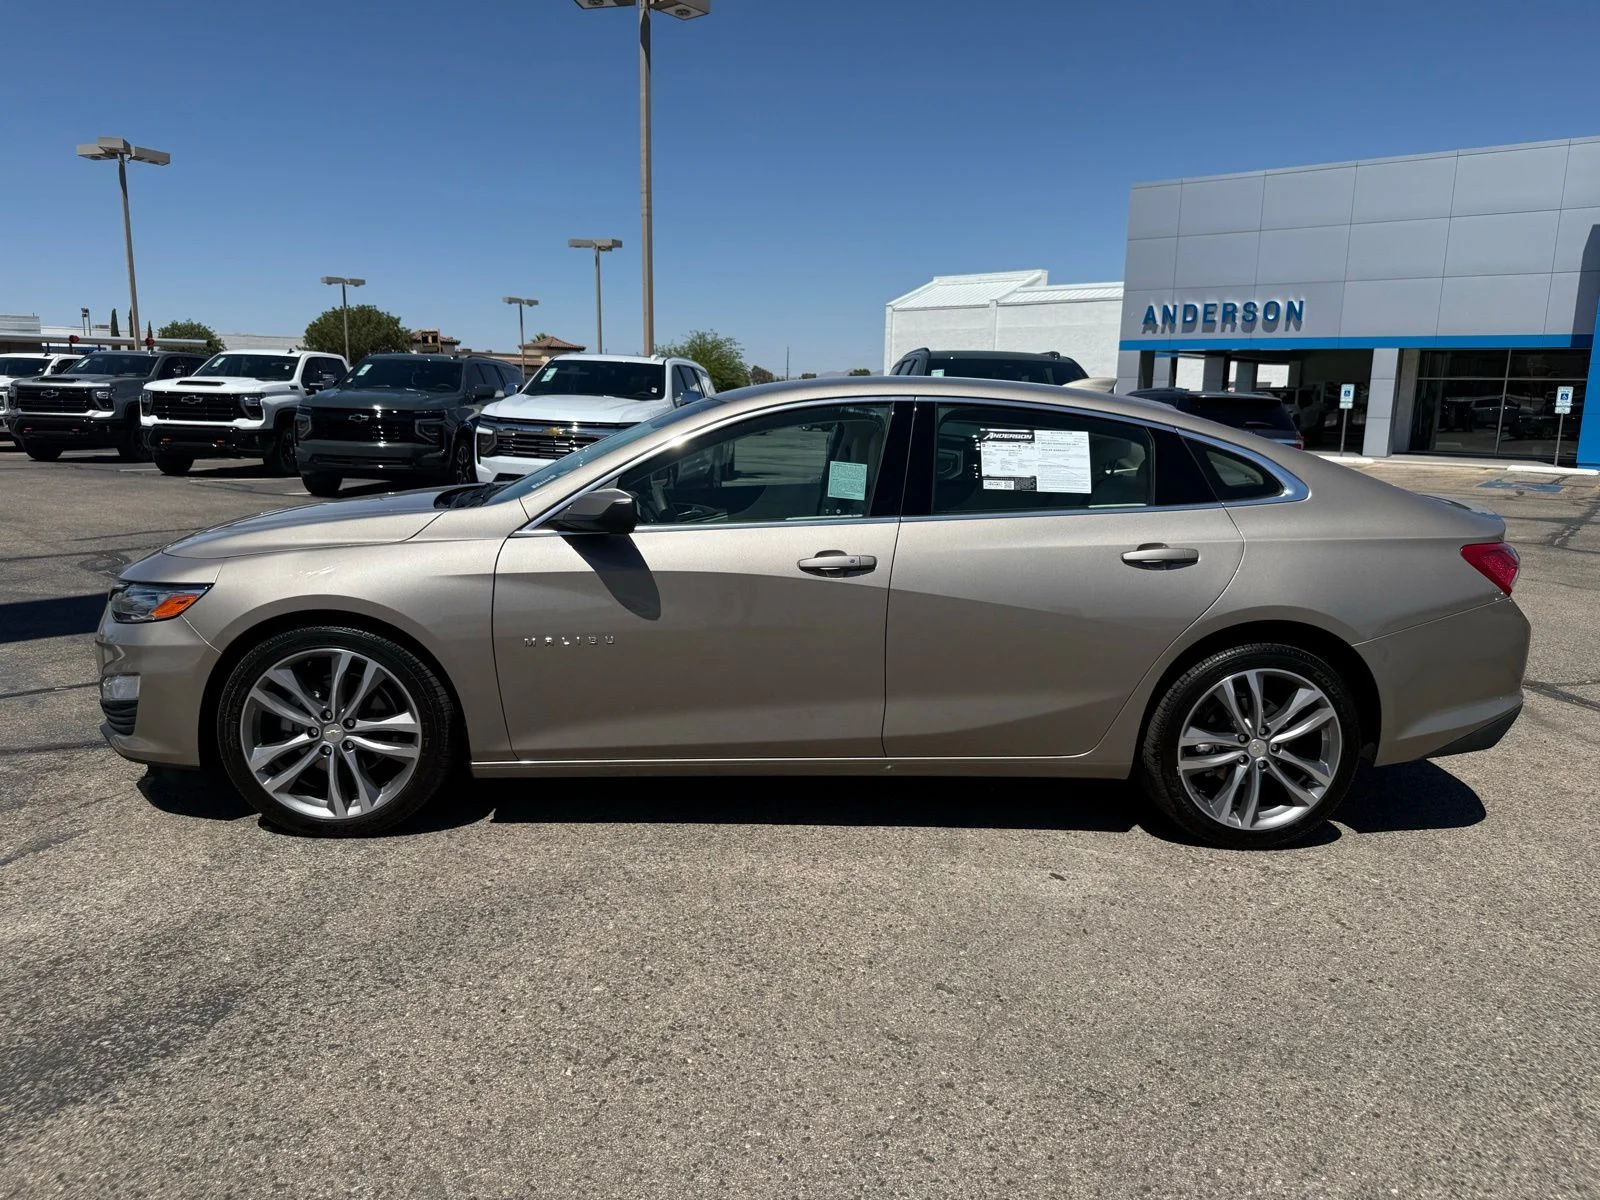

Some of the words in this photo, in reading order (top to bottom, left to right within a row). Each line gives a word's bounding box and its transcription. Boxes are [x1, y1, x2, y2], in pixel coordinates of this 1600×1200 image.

[1142, 300, 1304, 325] ANDERSON
[983, 432, 1032, 440] ANDERSON
[524, 635, 615, 647] MALIBU
